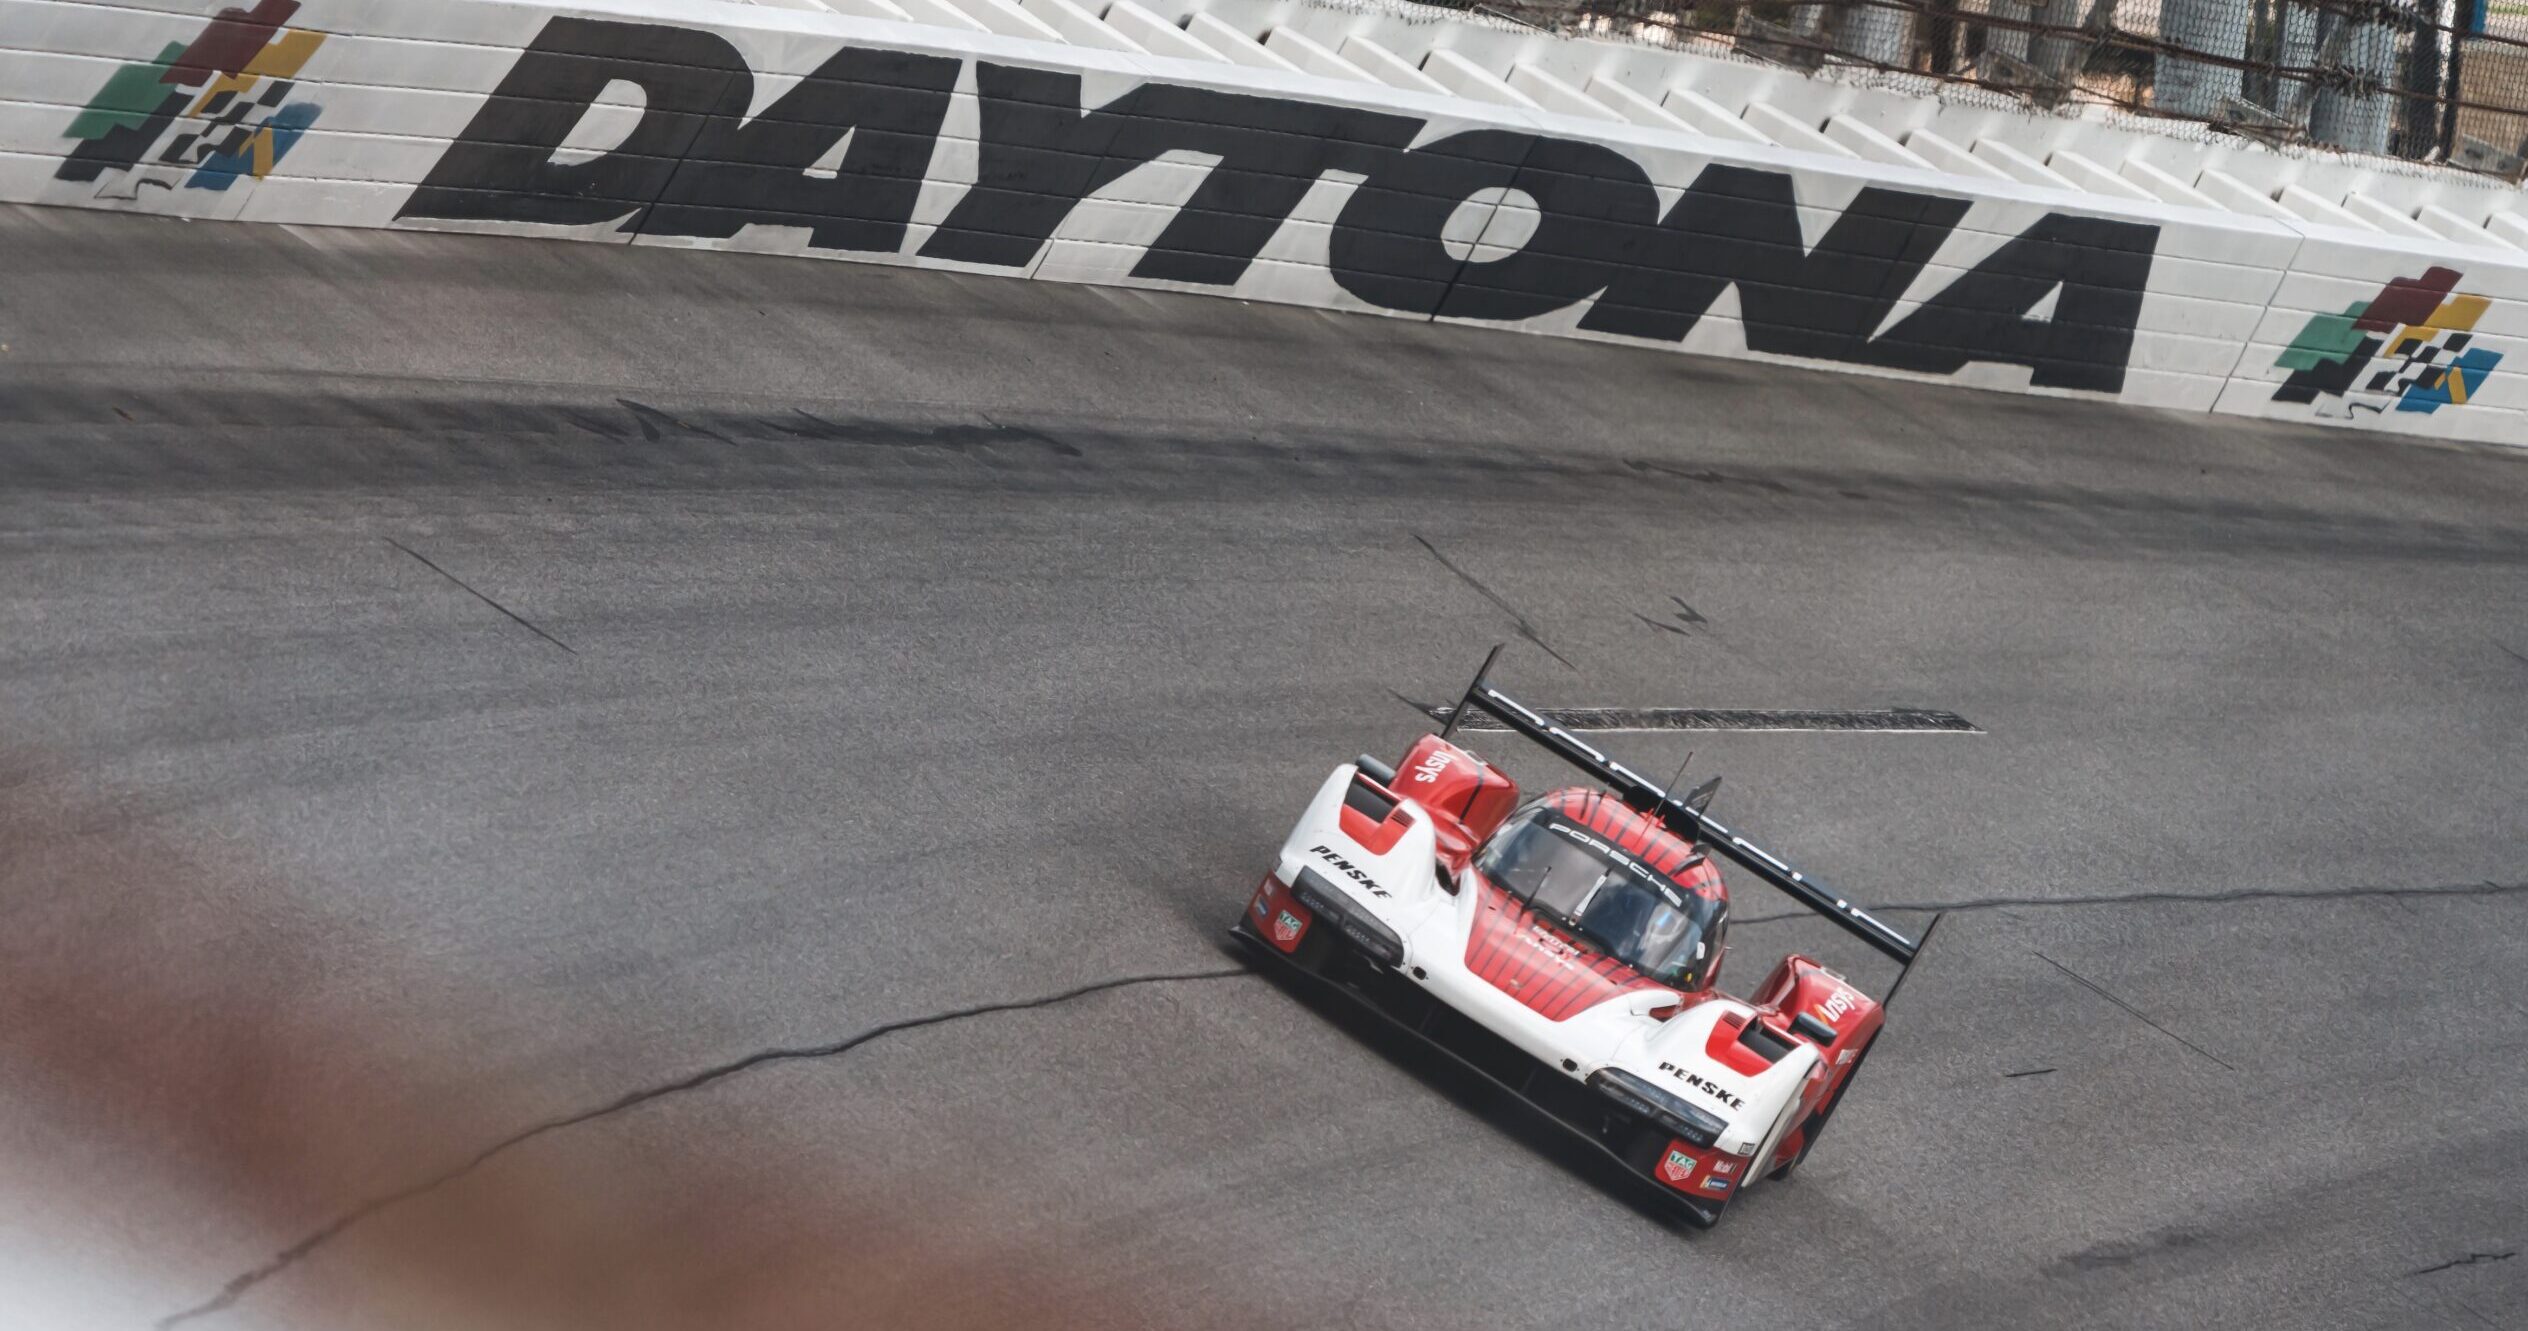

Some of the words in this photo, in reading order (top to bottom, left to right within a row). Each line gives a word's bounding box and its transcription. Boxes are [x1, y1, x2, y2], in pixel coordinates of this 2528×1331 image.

[392, 15, 2161, 394] DAYTONA
[1309, 845, 1392, 898] PENSKE
[1549, 822, 1682, 908] PORSCHE
[1658, 1062, 1746, 1111] PENSKE
[1671, 1152, 1696, 1171] TAG
